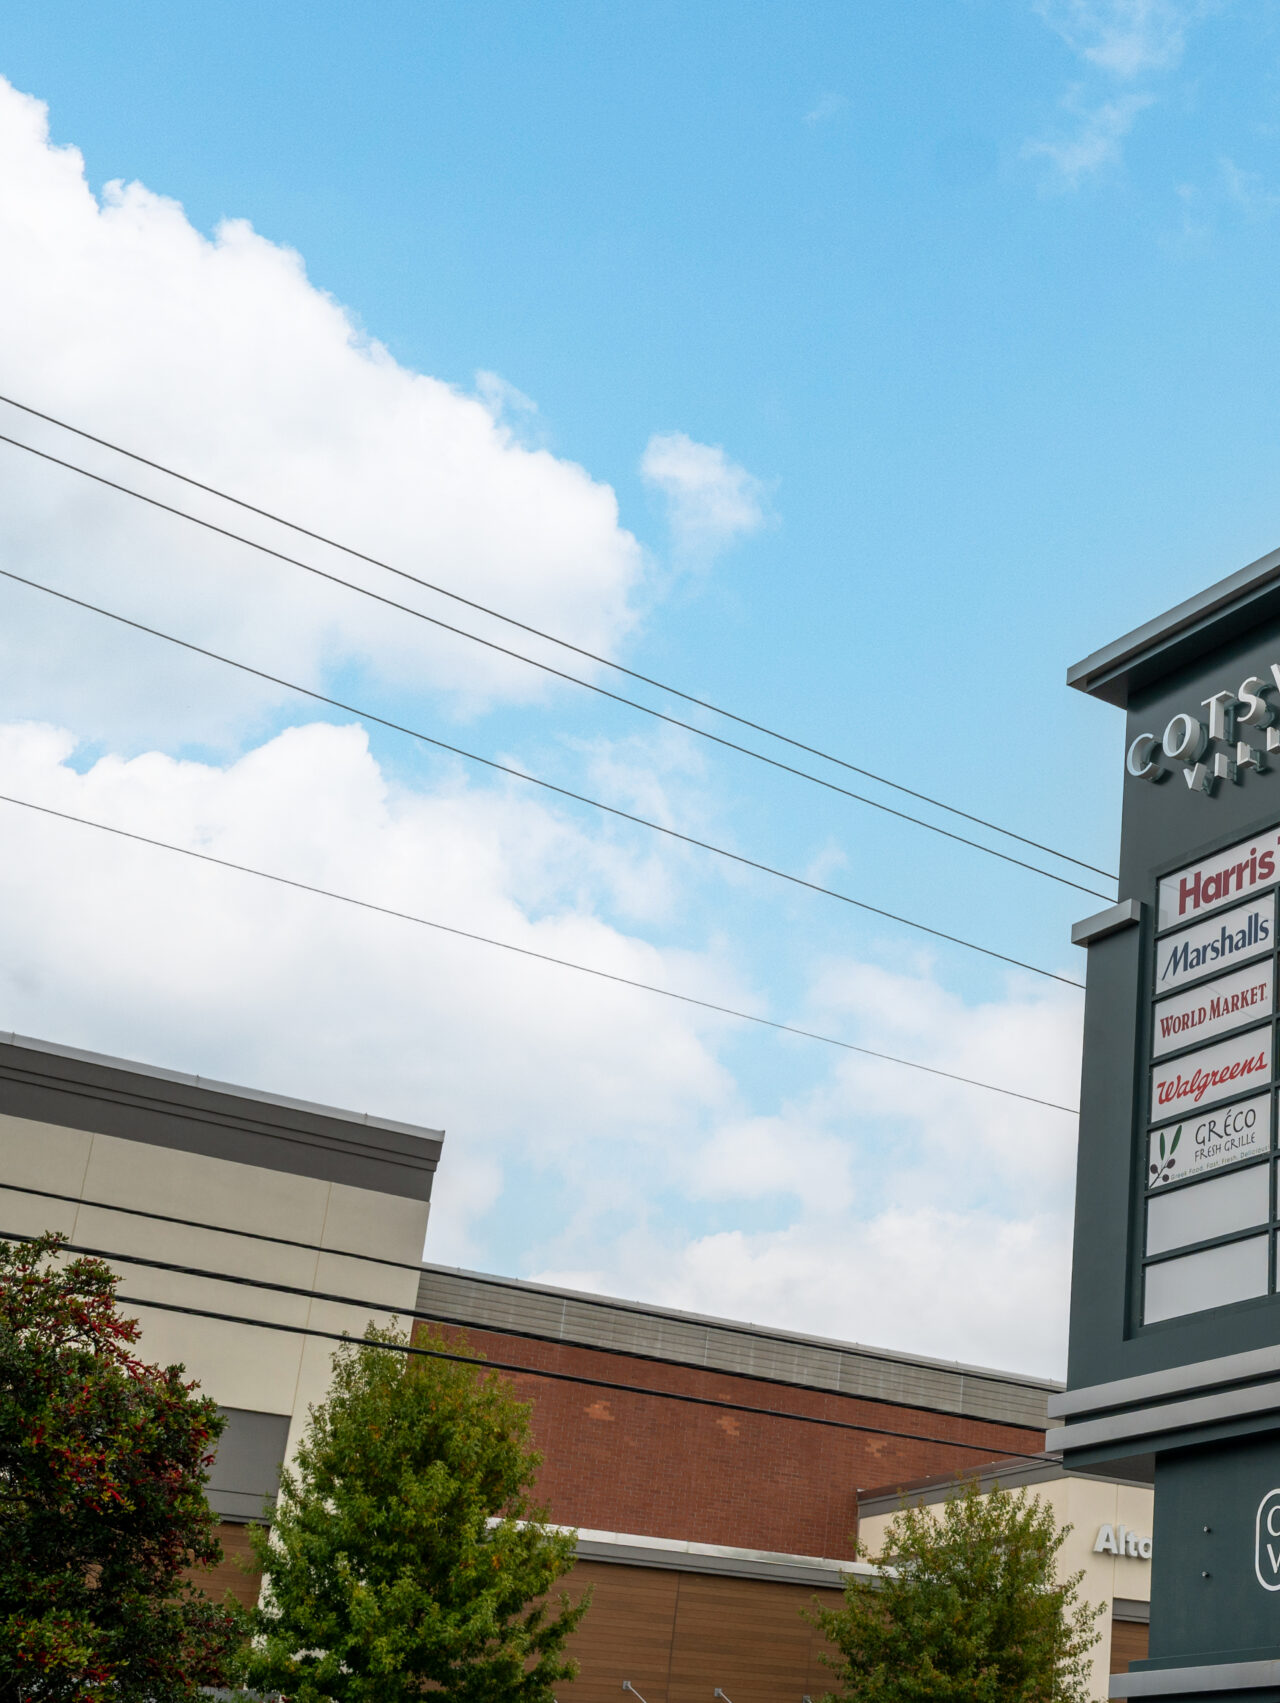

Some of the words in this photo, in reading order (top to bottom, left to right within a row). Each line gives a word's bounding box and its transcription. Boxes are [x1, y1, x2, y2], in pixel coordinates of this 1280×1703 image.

[1178, 847, 1275, 916] Harris
[1161, 912, 1270, 981] Marshalls
[1160, 1007, 1207, 1038] WORLD
[1208, 983, 1267, 1021] MARKET
[1157, 1051, 1268, 1105] Walgreens
[1194, 1143, 1222, 1163] FRESH
[1224, 1132, 1256, 1152] GRILLE
[1195, 1109, 1256, 1147] GRÉCO
